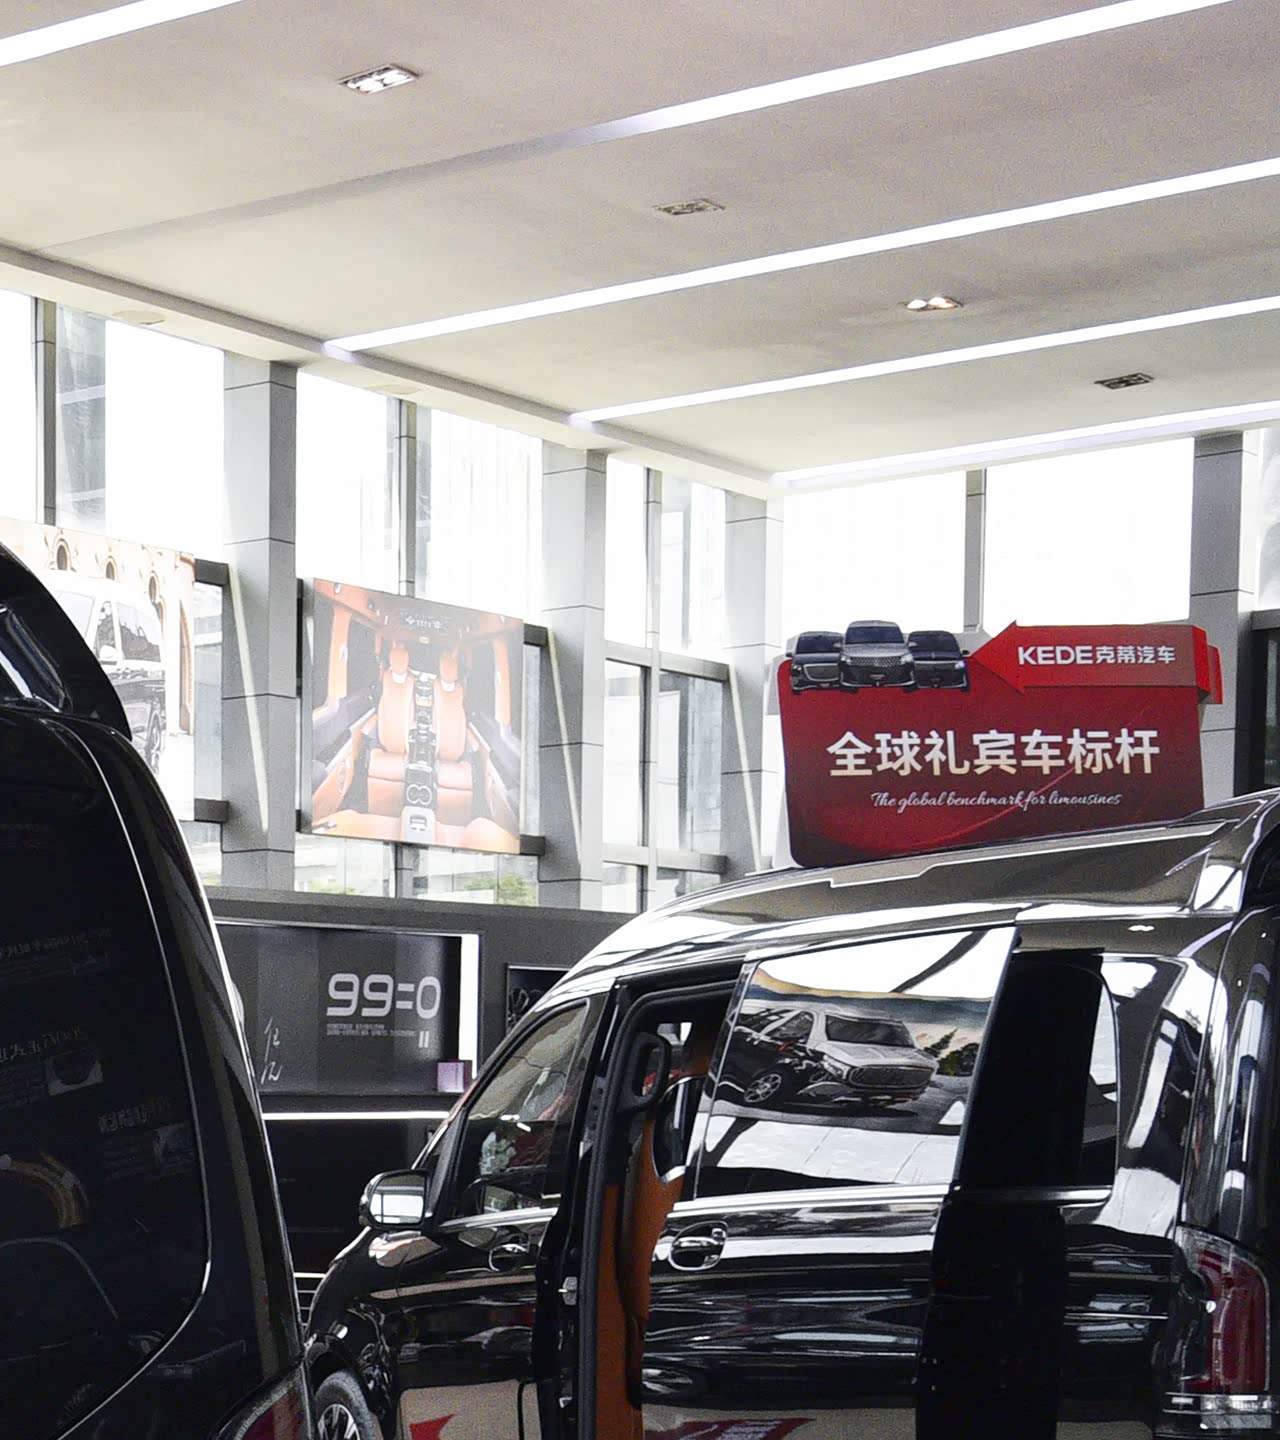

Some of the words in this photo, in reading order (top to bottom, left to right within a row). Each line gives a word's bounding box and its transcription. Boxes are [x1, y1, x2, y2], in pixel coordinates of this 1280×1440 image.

[1017, 646, 1093, 665] KEDE
[1095, 645, 1176, 665] 克蒂汽车
[826, 728, 1160, 777] 全球礼宾车标杆
[871, 792, 896, 808] The
[898, 791, 945, 814] global
[947, 790, 1023, 808] benchmark
[1022, 789, 1048, 811] for
[1048, 789, 1123, 806] limousines
